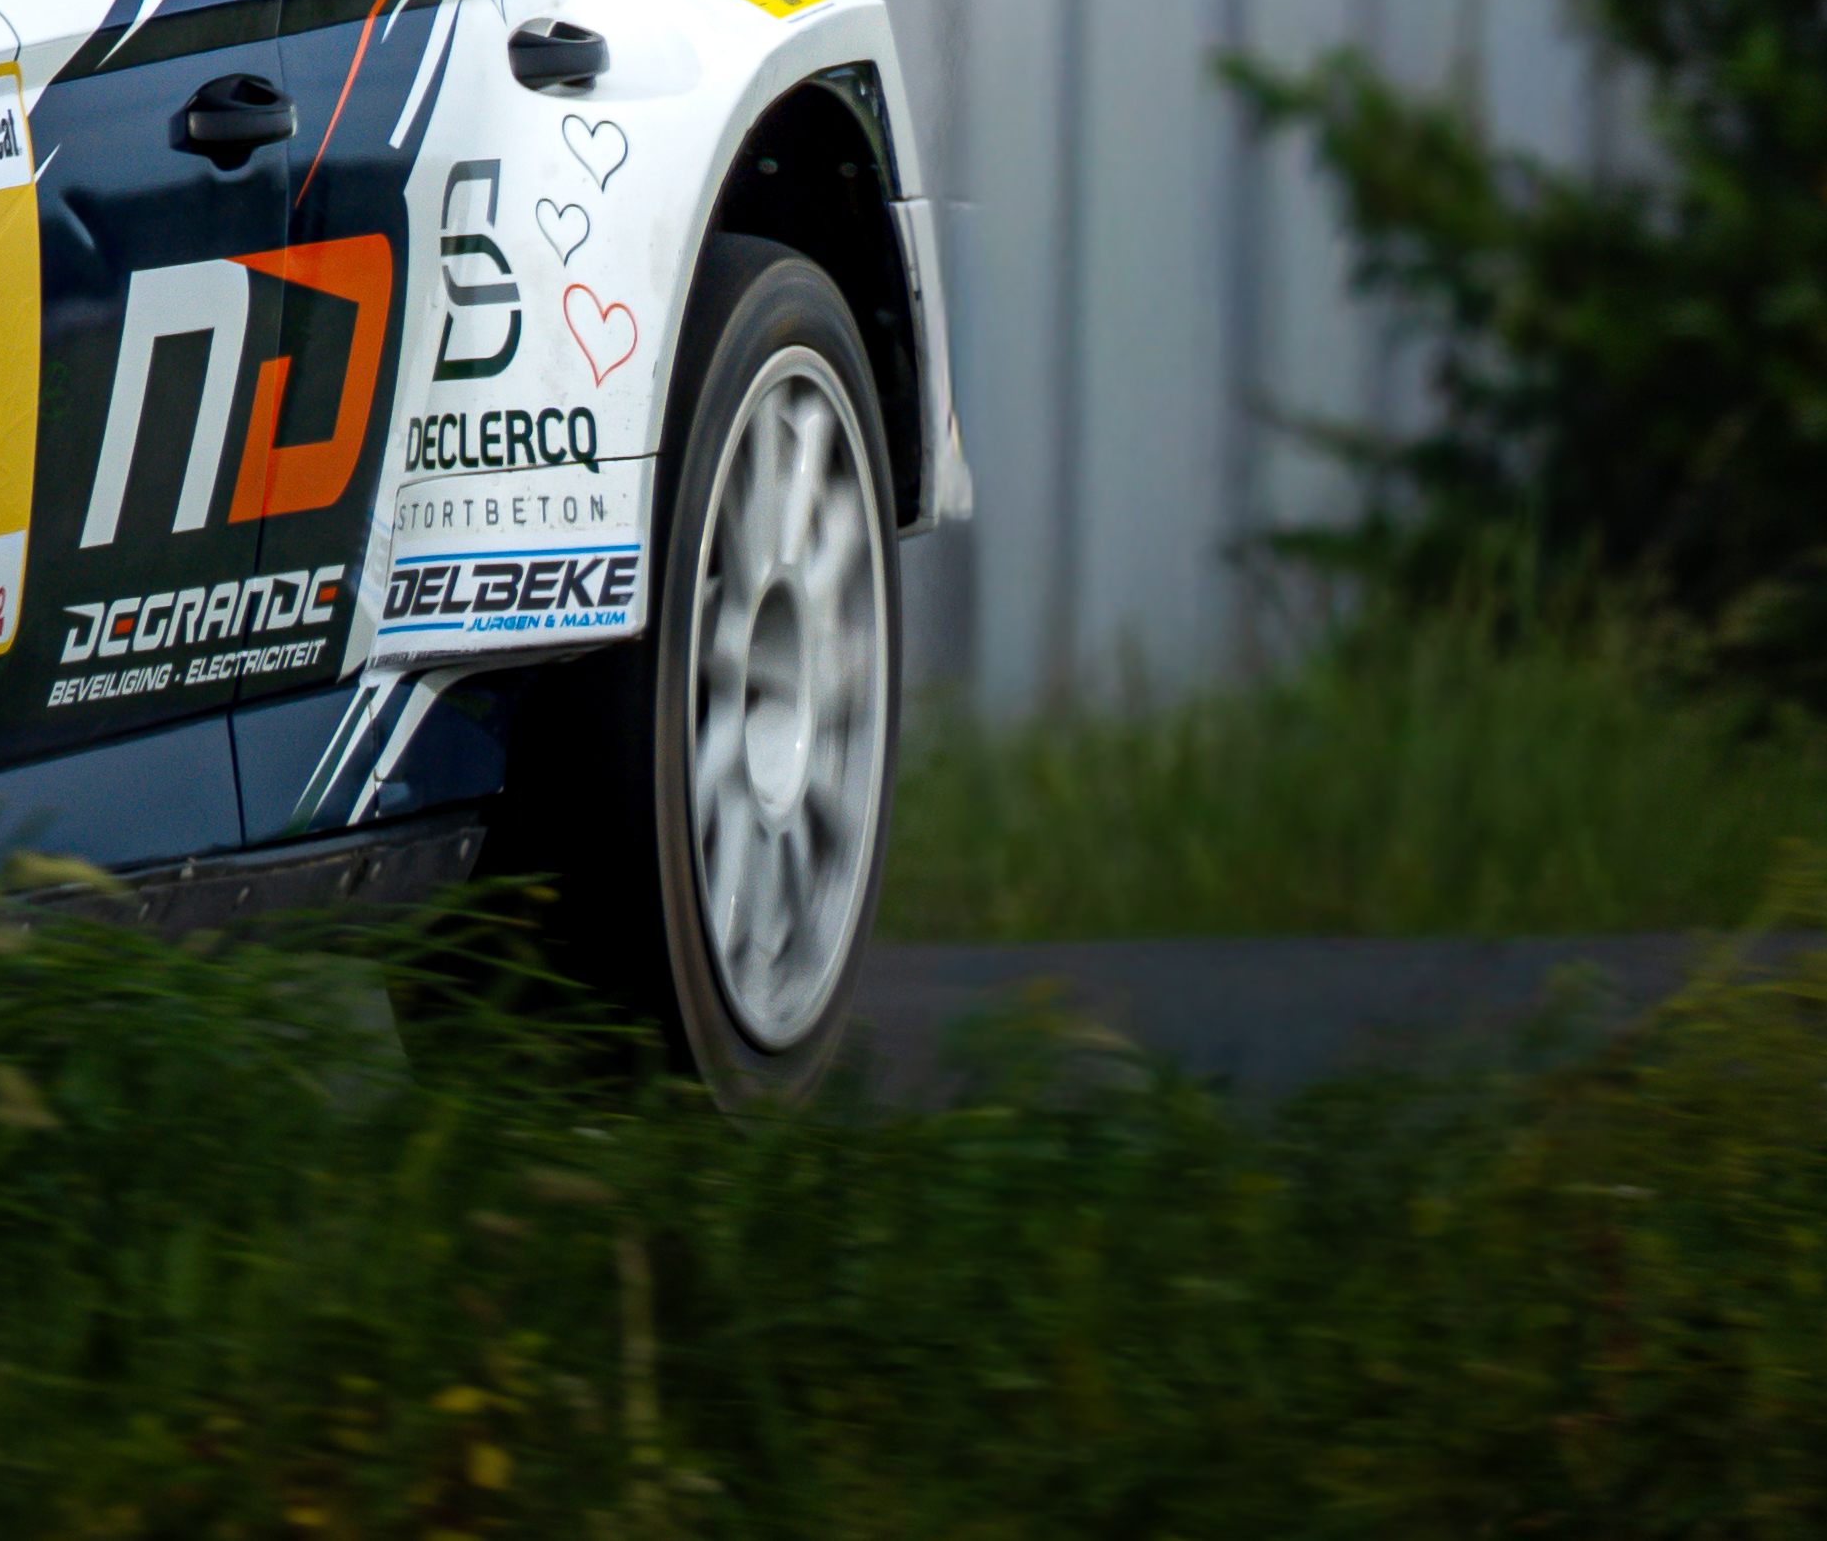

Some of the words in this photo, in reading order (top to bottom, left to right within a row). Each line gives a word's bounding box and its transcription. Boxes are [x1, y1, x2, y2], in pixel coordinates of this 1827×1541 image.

[404, 406, 601, 475] DECLERCQ
[397, 493, 605, 532] STORTBETON
[60, 563, 346, 665] DEGRANDE
[382, 555, 640, 621] DELBEKE
[465, 613, 542, 632] JURGEN
[559, 611, 626, 628] MAXIM
[46, 662, 174, 708] BEVEILIGING
[183, 637, 328, 686] ELECTRICITEIT
